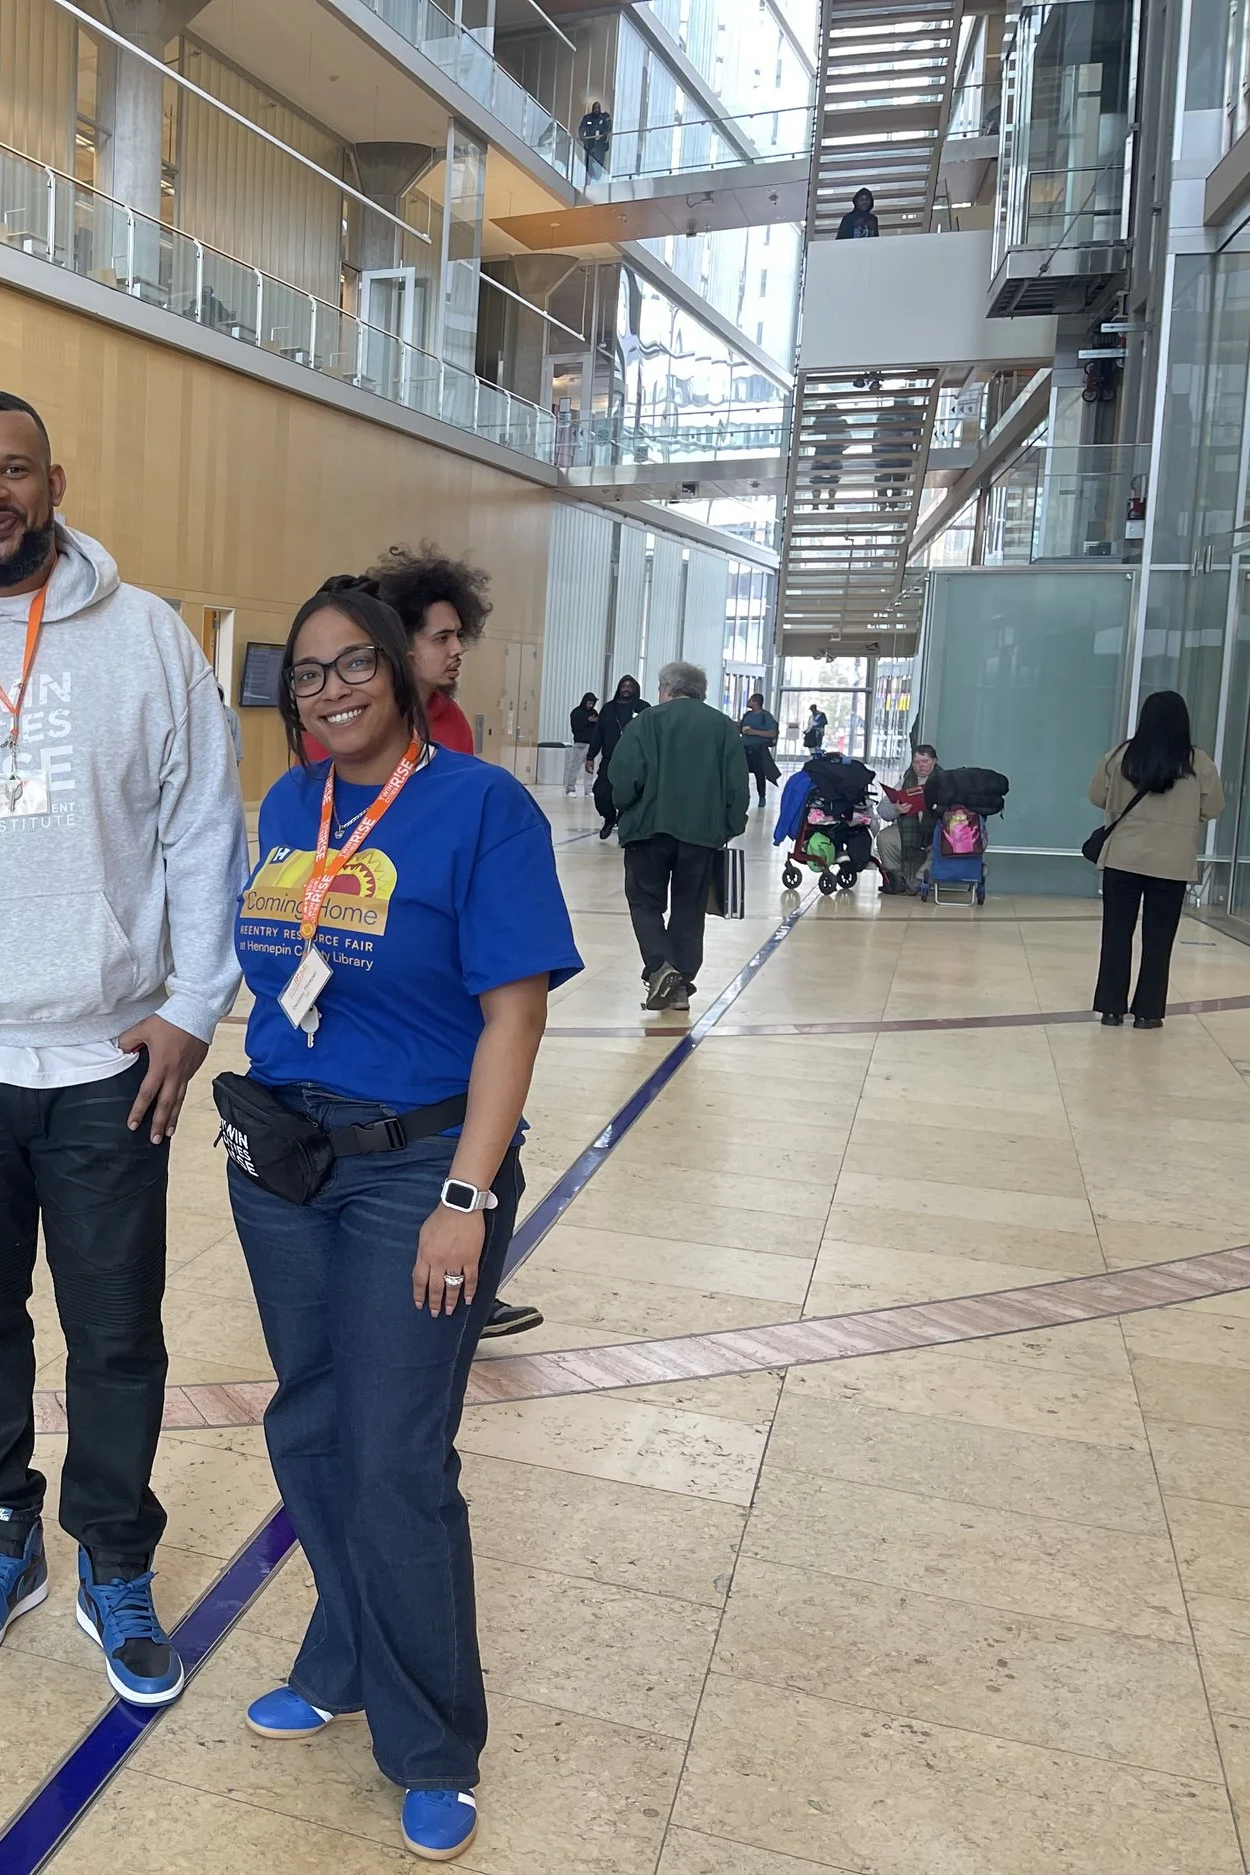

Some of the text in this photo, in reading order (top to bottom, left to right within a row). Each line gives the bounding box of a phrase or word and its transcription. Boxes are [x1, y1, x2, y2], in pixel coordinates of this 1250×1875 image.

[240, 925, 279, 938] REENTRY
[345, 938, 374, 952] FAIR
[247, 941, 291, 957] Hennepin
[333, 953, 374, 971] Library
